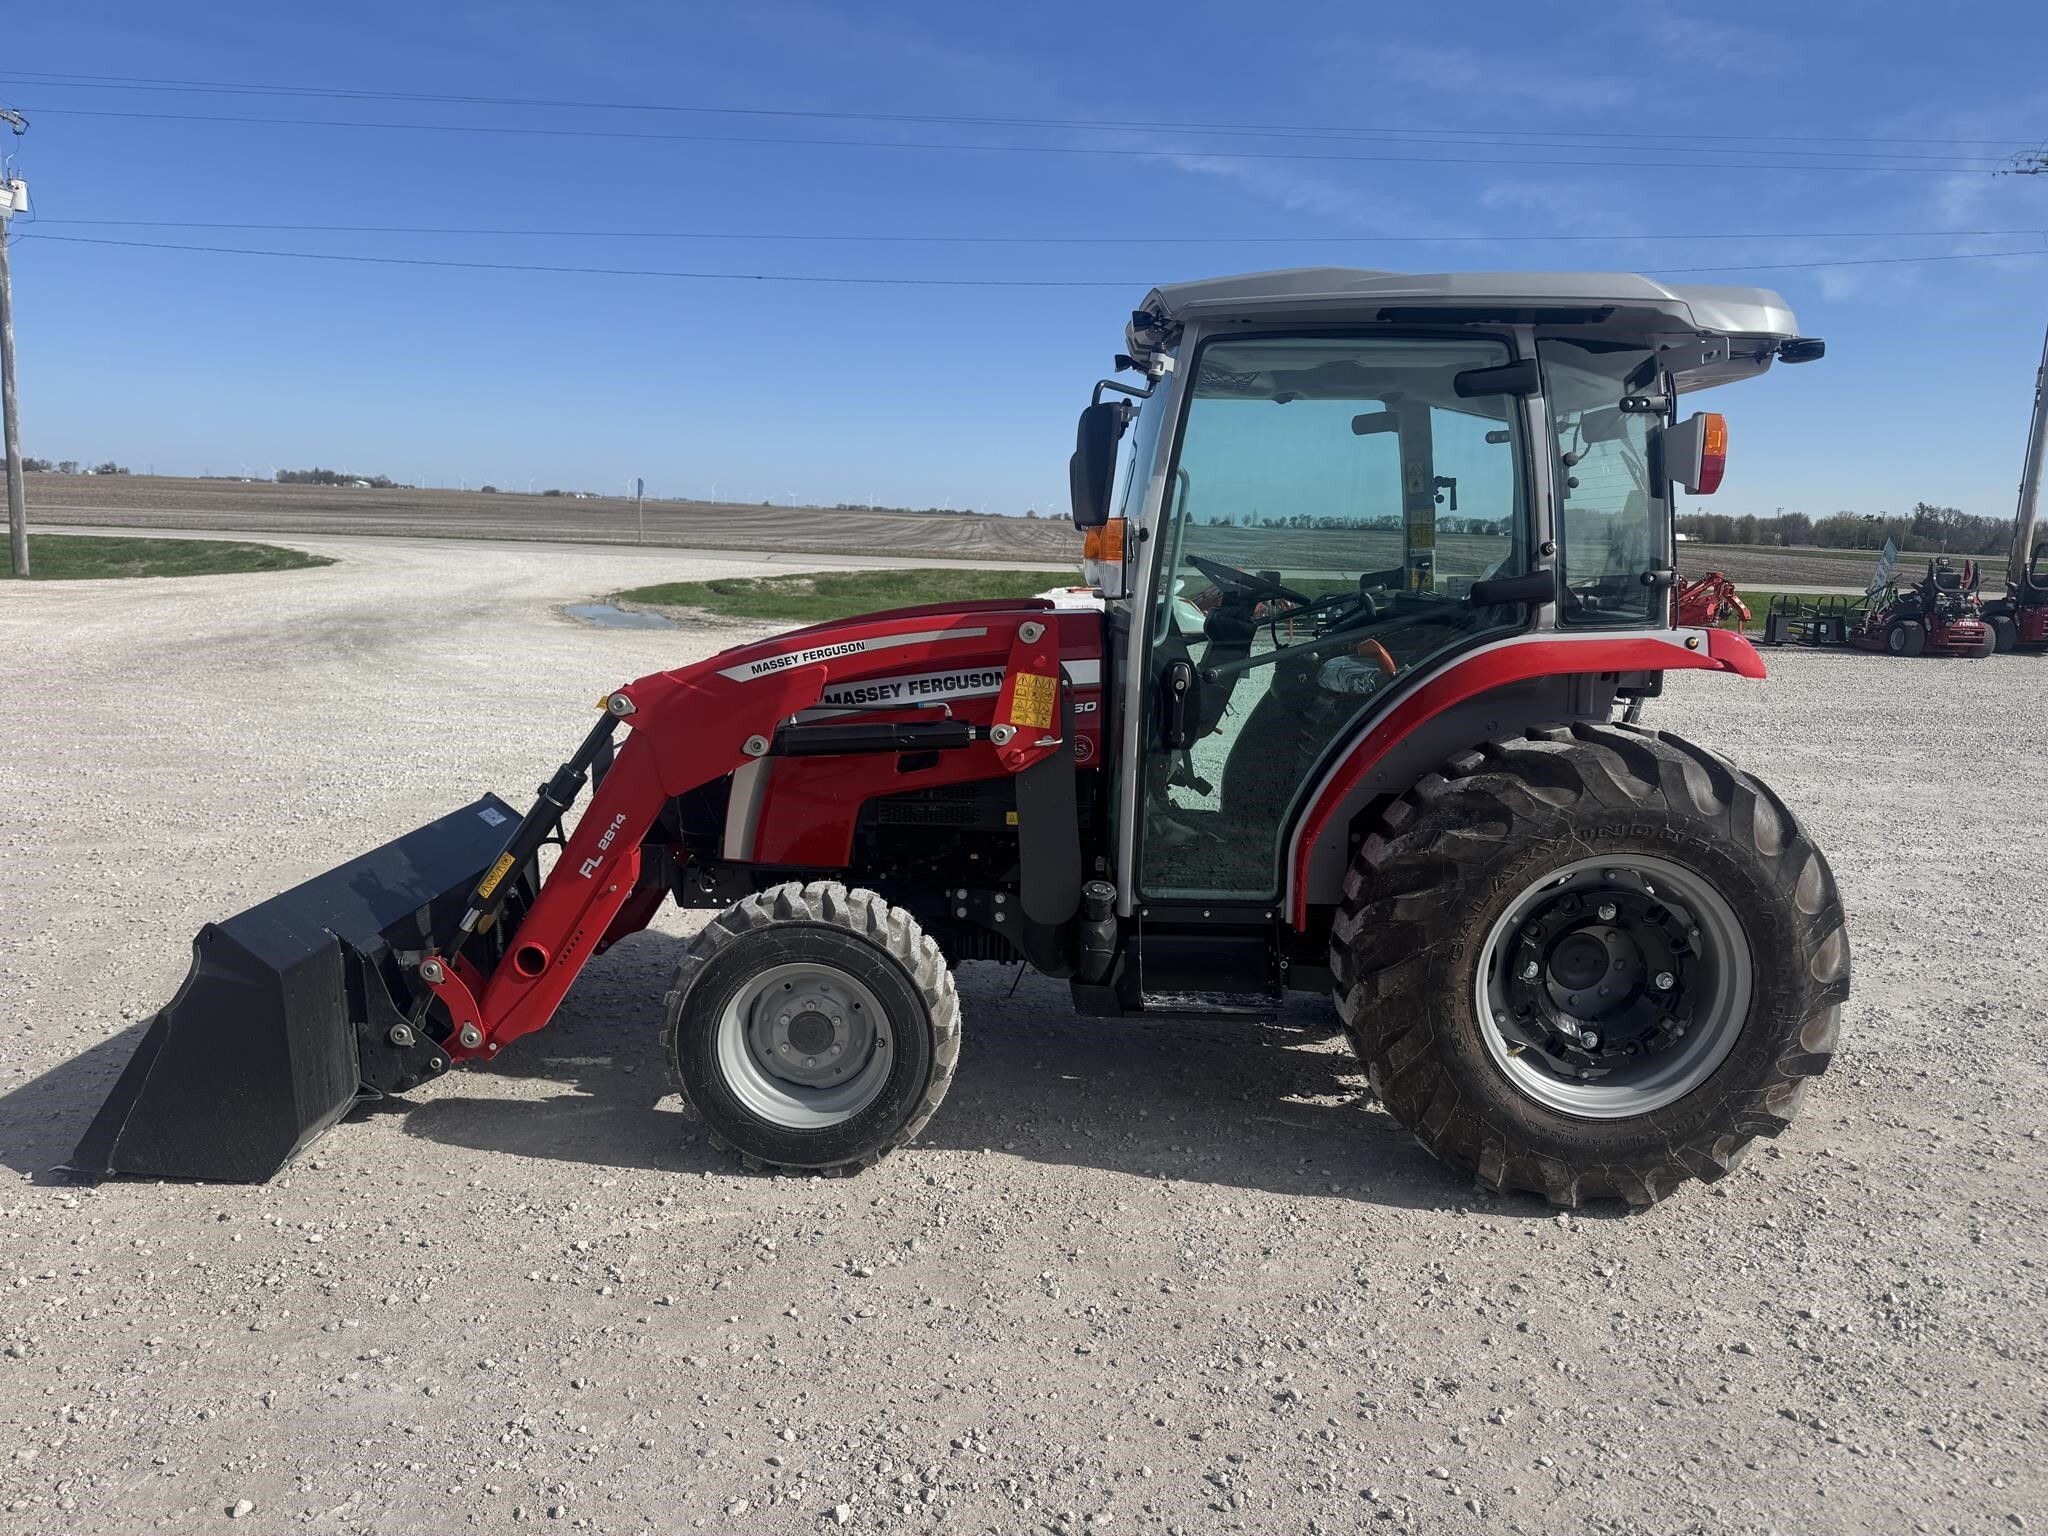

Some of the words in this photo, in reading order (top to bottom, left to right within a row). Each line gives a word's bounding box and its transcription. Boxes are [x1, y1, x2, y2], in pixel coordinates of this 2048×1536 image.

[751, 655, 799, 675] MASSEY
[803, 642, 865, 661] FERGUSON
[824, 683, 902, 704] MASSEY
[909, 672, 1005, 695] FERGUSON
[579, 855, 603, 879] FL
[598, 813, 627, 851] 2814
[1449, 839, 1561, 965] GALAXY
